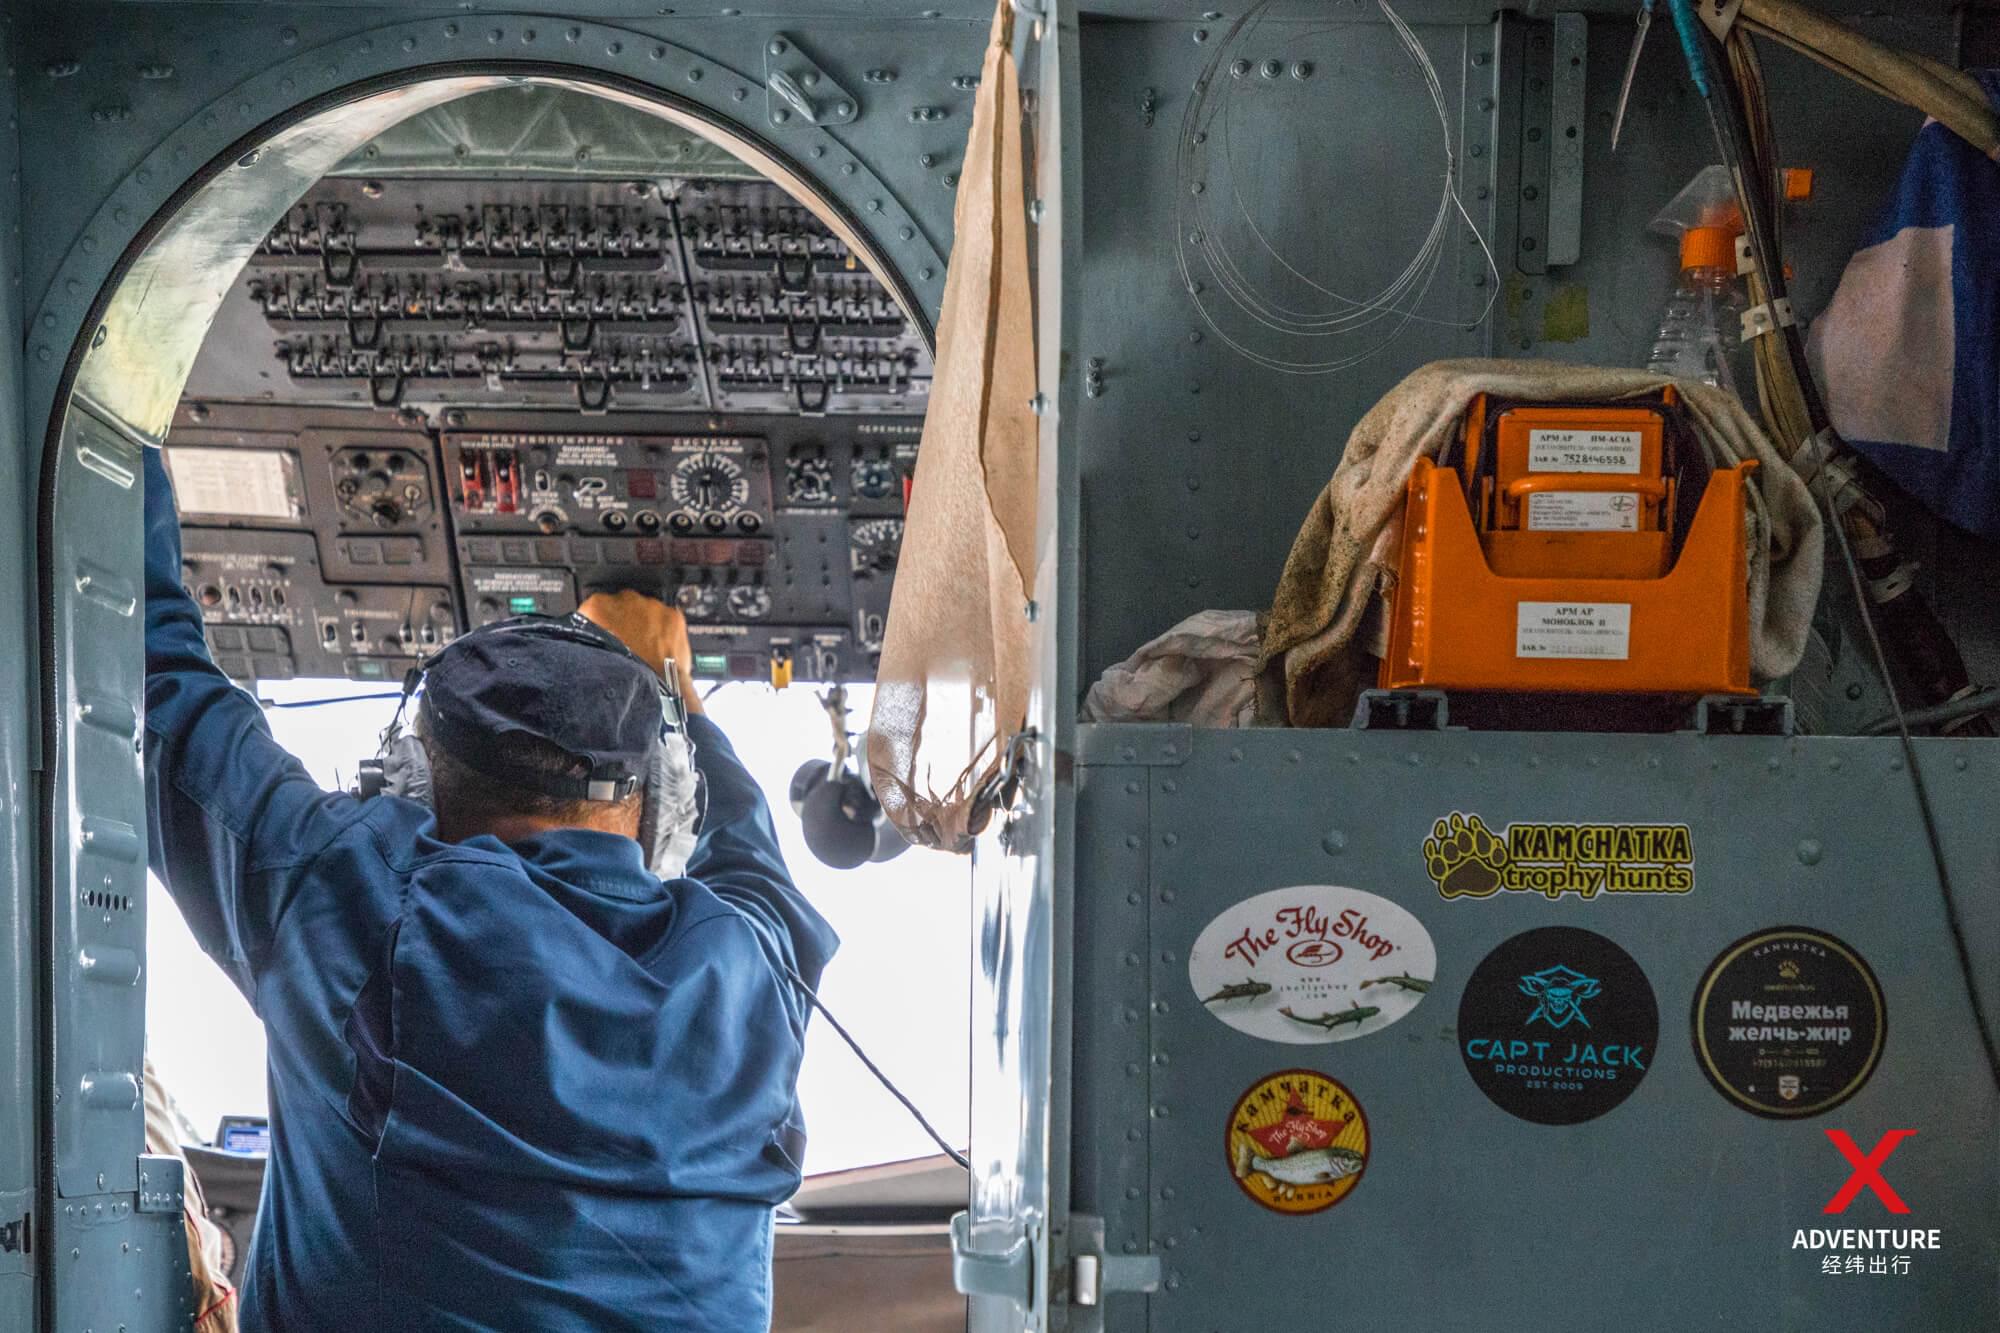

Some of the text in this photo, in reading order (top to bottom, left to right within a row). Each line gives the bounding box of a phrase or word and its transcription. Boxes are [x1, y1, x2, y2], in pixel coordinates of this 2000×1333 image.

[1510, 827, 1691, 861] KAMCHATKA
[1505, 864, 1692, 897] trophy hunts
[1225, 905, 1395, 968] The Fly Shop
[1753, 943, 1826, 959] КАМЧАТКА
[1731, 1001, 1849, 1023] Медвежья
[1728, 1025, 1852, 1045] желчь-жир
[1467, 1039, 1646, 1071] CAPT JACK
[1495, 1064, 1617, 1080] PRODUCTIONS
